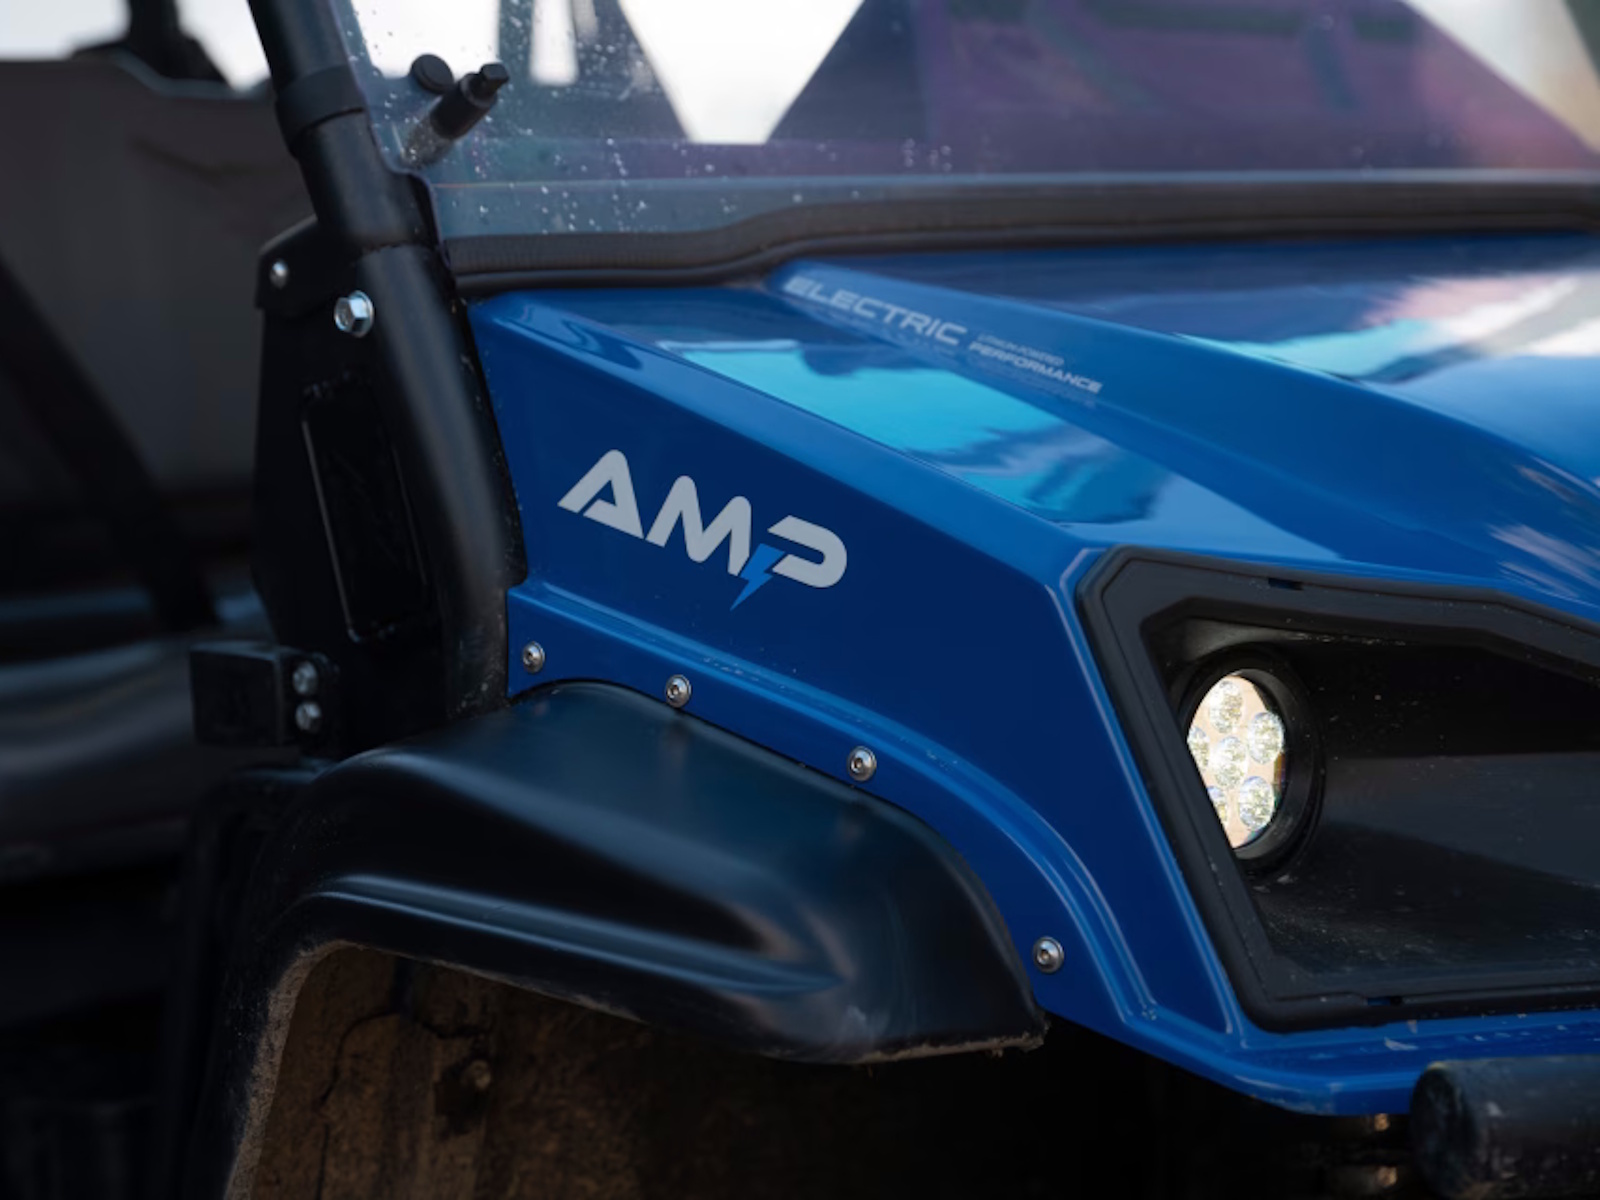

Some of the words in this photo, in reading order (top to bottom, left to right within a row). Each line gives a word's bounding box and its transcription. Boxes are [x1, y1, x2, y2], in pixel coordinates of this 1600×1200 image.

[783, 275, 968, 346] ELECTRIC
[969, 341, 1103, 394] PERFORMANCE
[557, 449, 847, 588] AMP
